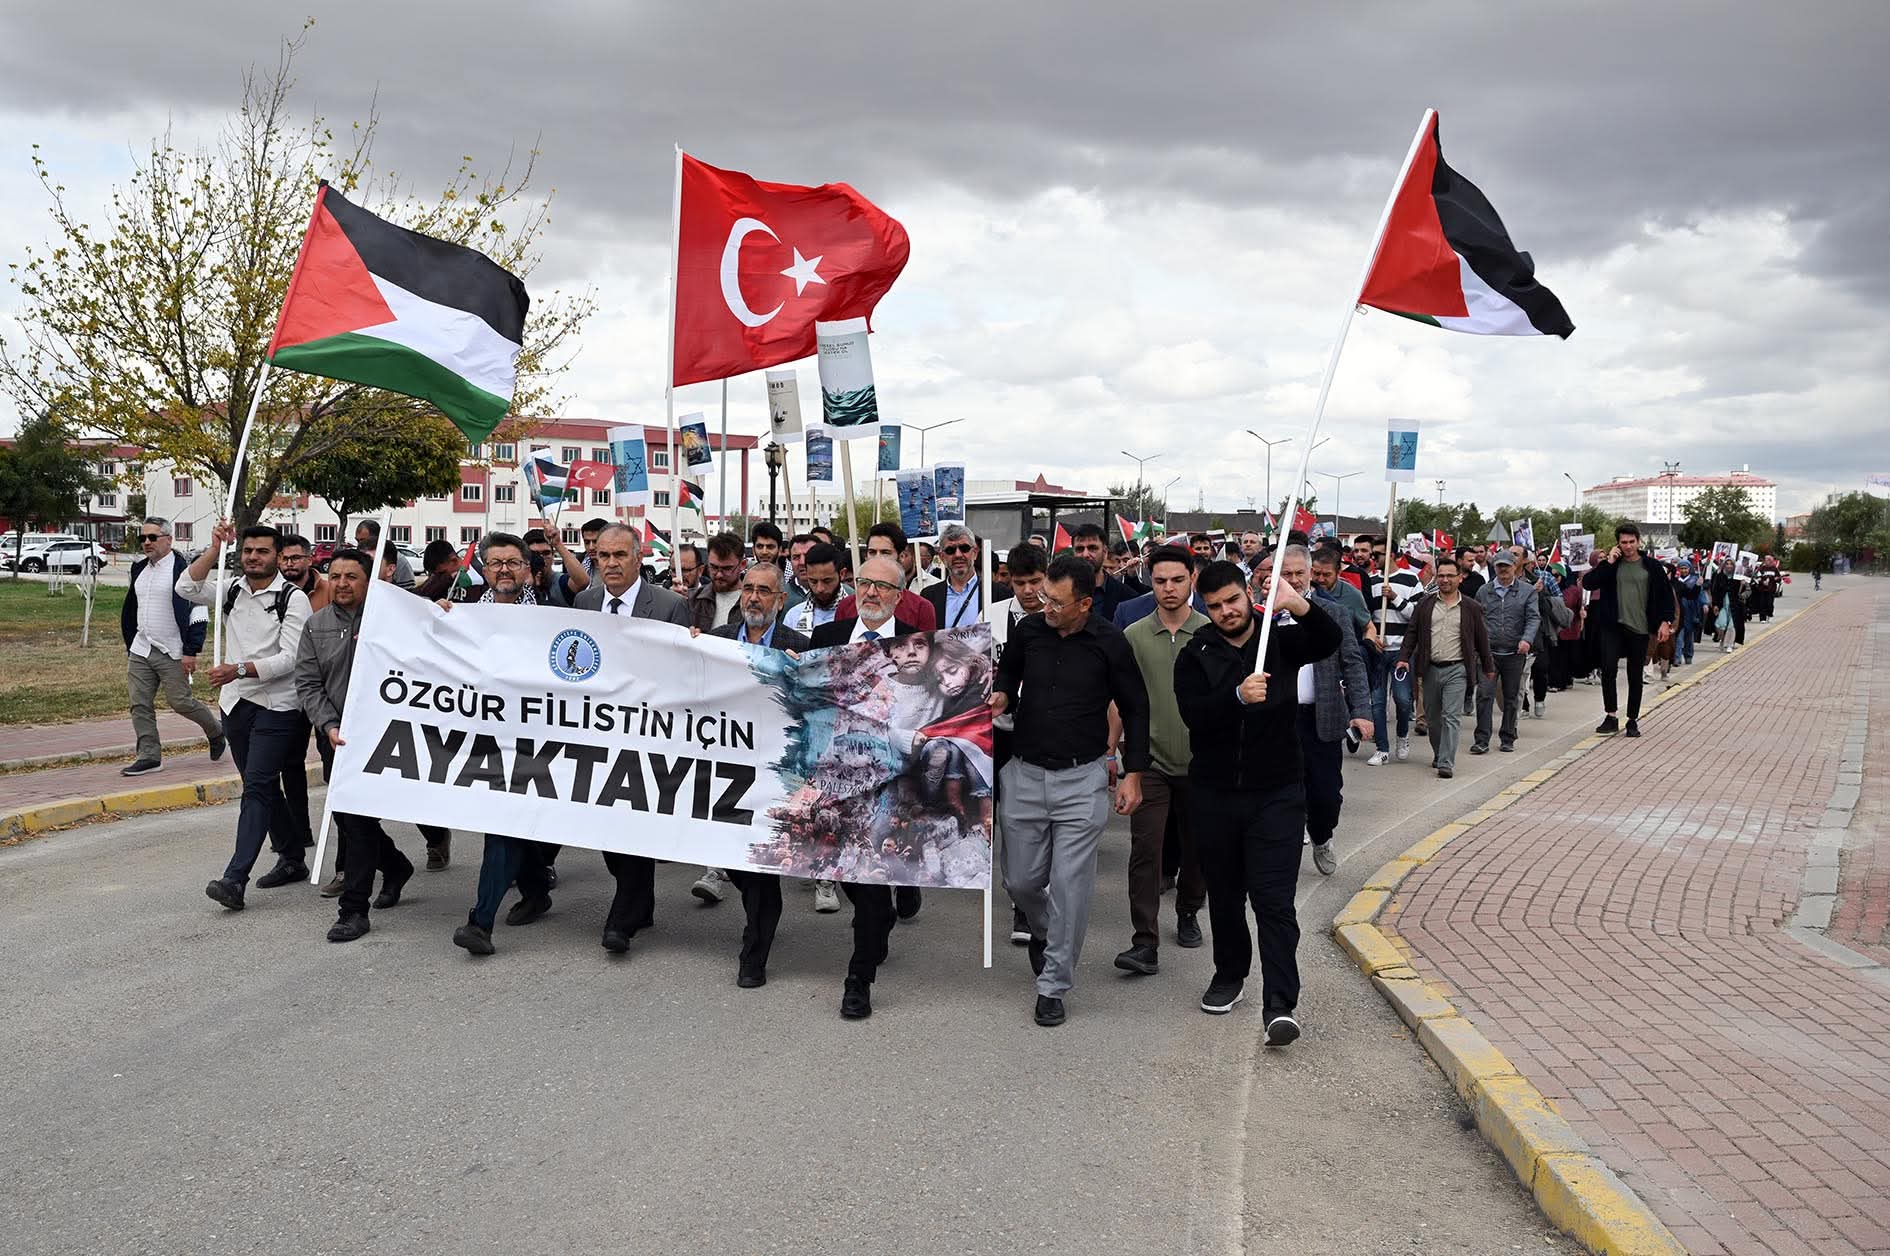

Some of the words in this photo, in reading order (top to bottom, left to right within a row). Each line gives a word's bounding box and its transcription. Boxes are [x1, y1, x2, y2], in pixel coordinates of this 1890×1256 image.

[948, 630, 977, 640] SYRIA
[380, 670, 505, 722] ÖZGÜR
[520, 692, 674, 739] FİLİSTİN
[685, 708, 755, 750] İÇİN
[362, 719, 756, 826] AYAKTAYIZ
